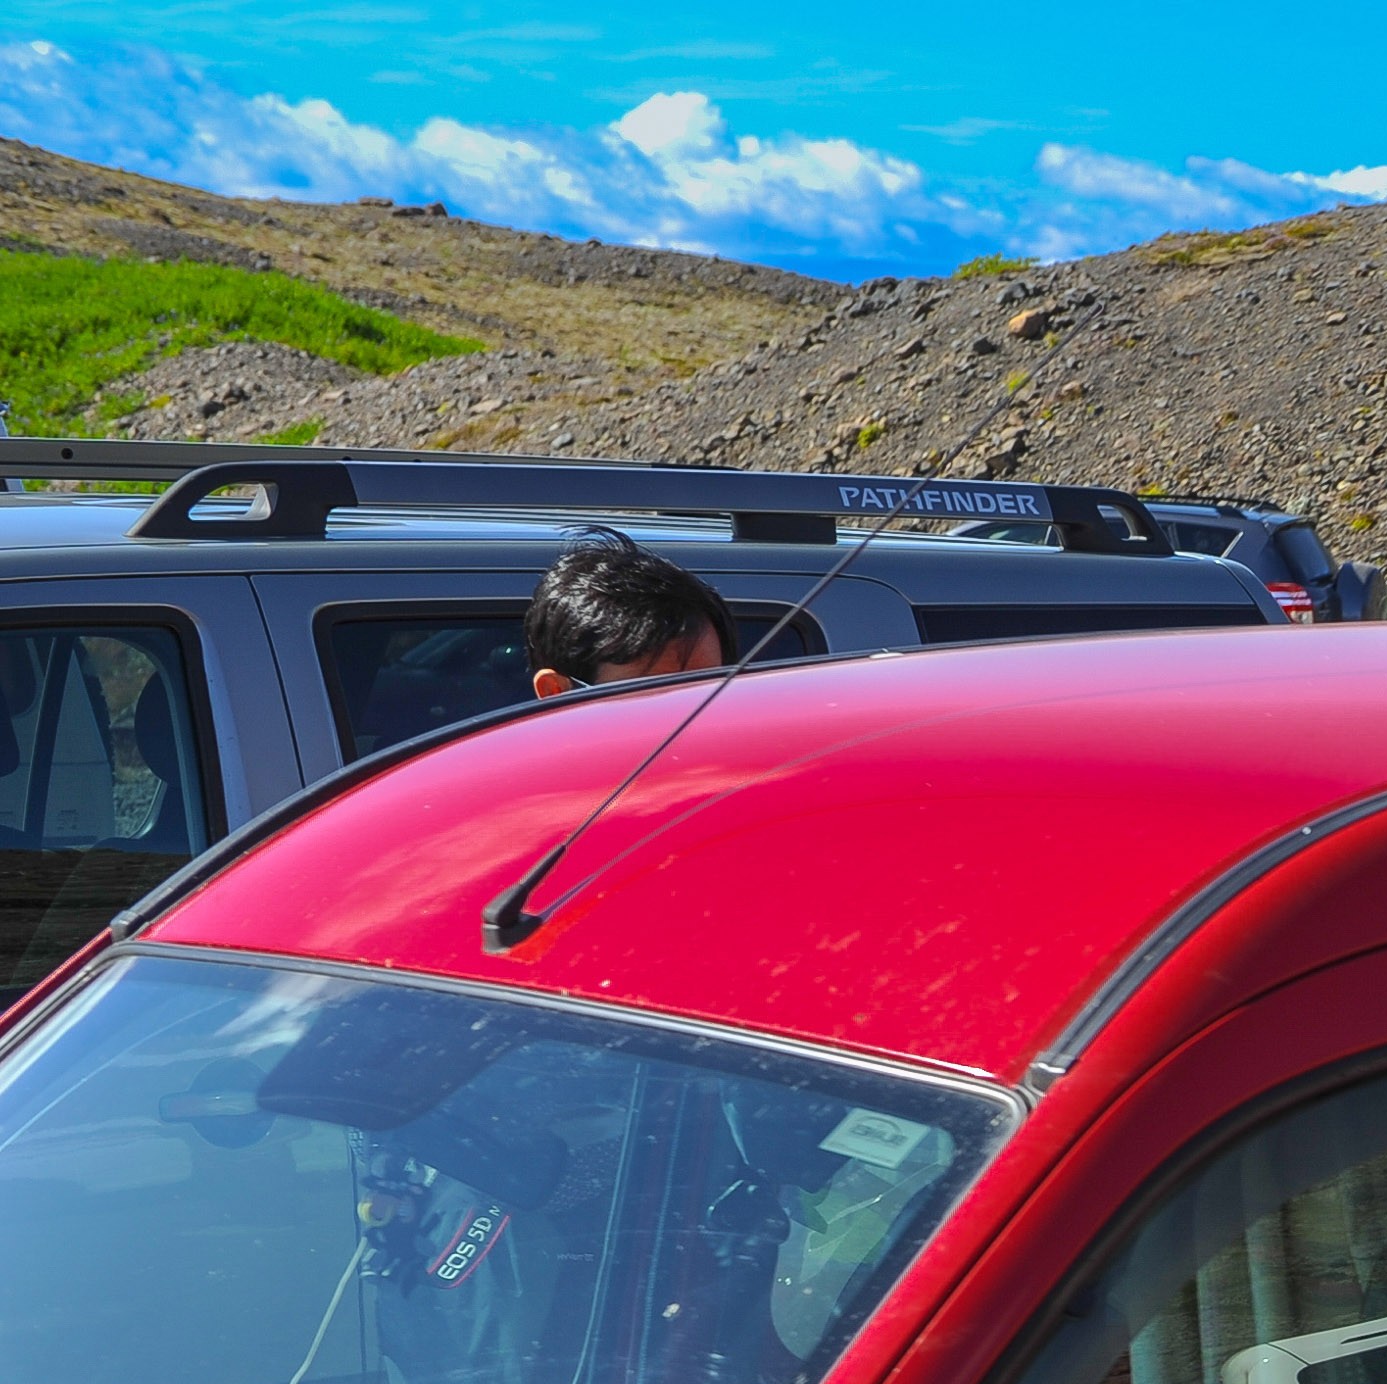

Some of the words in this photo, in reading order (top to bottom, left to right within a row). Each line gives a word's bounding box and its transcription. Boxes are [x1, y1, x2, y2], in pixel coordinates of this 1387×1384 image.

[838, 486, 1041, 515] PATHFINDER
[436, 1240, 477, 1280] EOS
[466, 1216, 493, 1242] 5D
